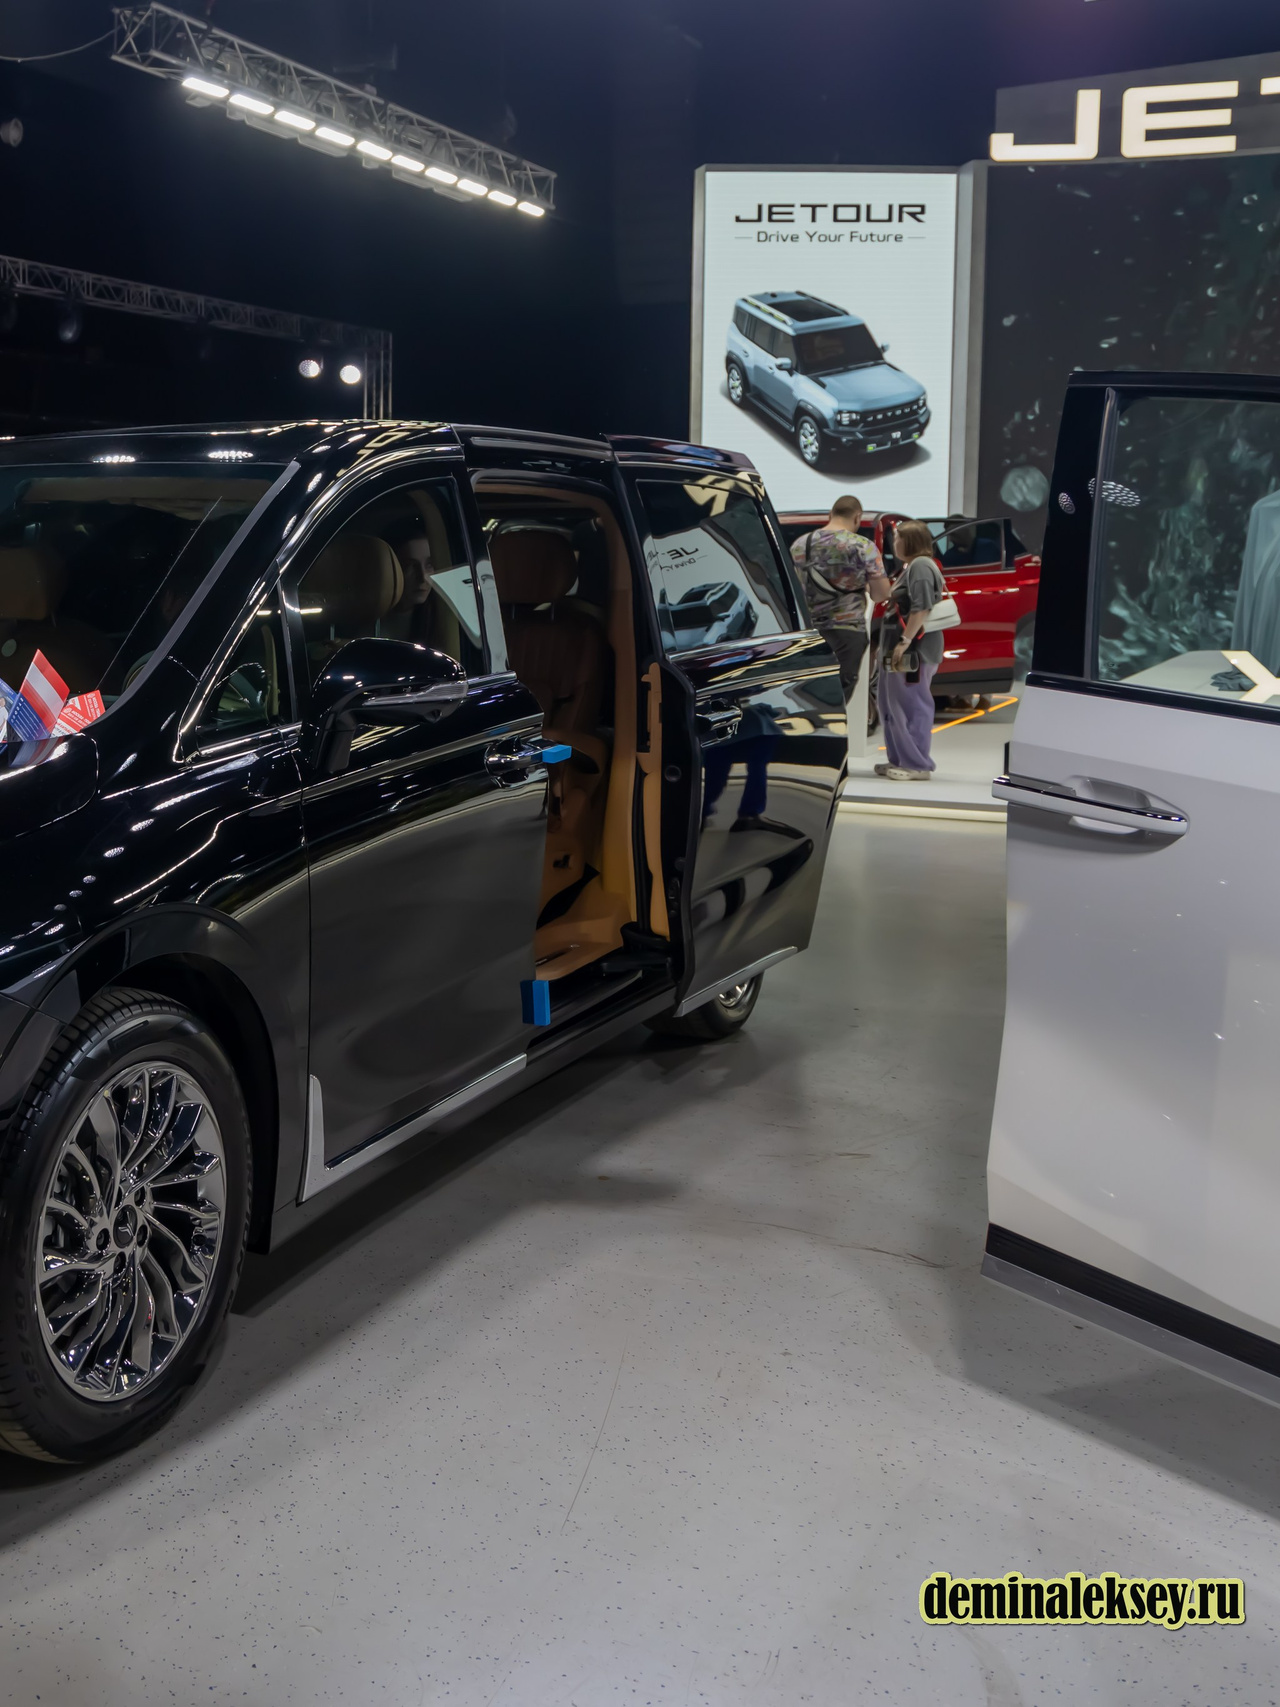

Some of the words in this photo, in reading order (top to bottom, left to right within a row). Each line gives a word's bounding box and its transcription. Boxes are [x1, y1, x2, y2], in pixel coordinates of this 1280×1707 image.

[990, 77, 1280, 162] JE
[735, 203, 926, 223] JETOUR
[757, 231, 800, 243] Drive
[805, 231, 845, 243] Your
[849, 230, 904, 243] Future
